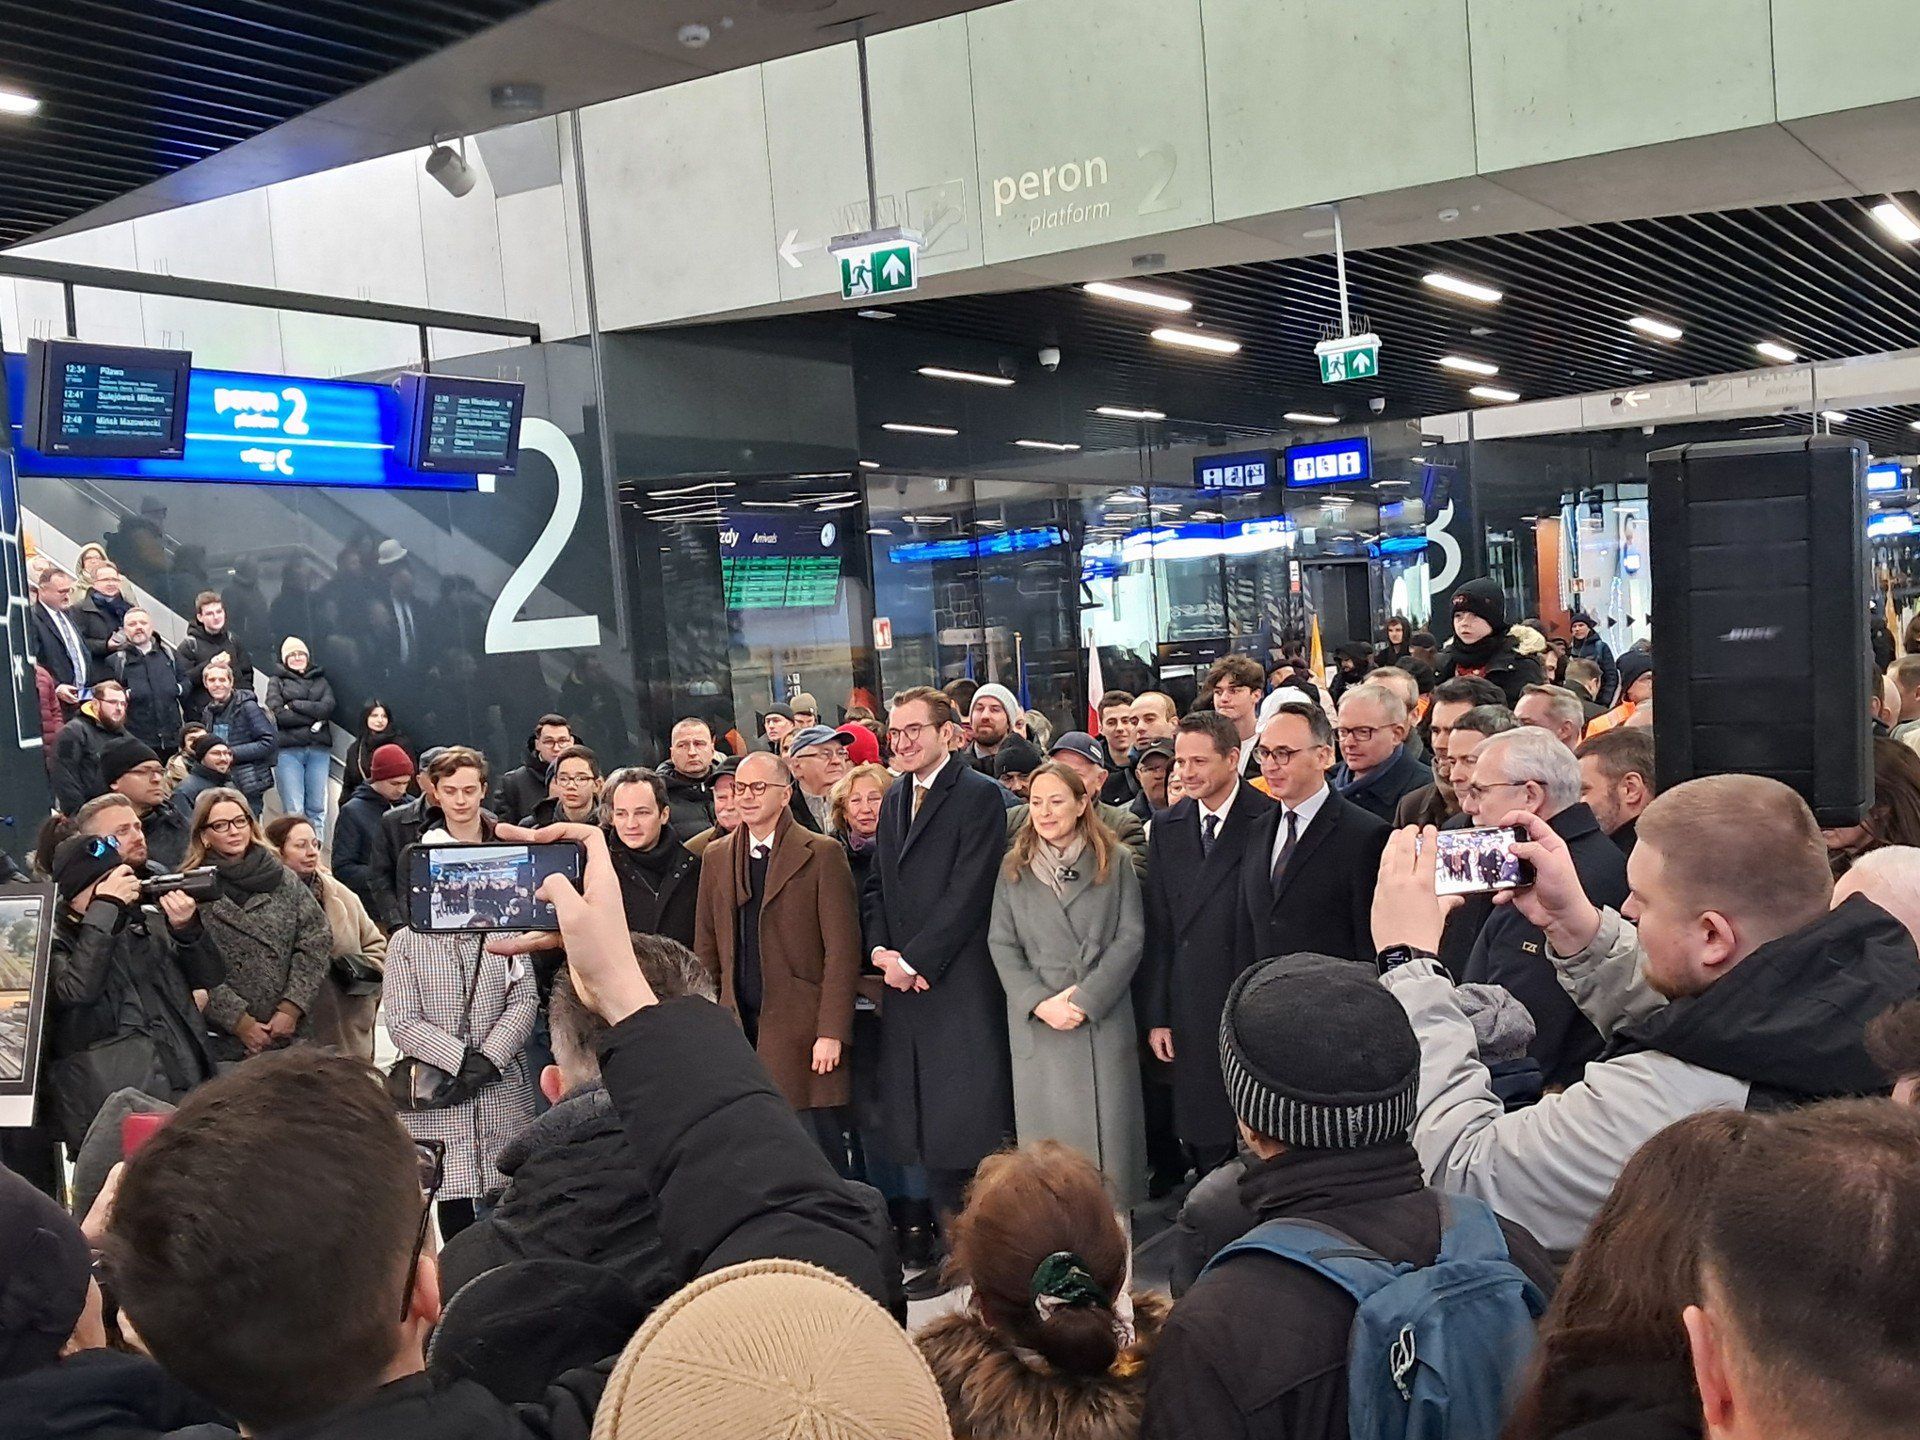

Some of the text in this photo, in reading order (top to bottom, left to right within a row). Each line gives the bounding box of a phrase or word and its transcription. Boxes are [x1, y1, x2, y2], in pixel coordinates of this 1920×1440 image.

[993, 156, 1109, 217] peron
[1028, 200, 1111, 237] platform
[281, 387, 309, 435] 2
[477, 417, 601, 654] 2
[751, 532, 778, 544] Arrivals
